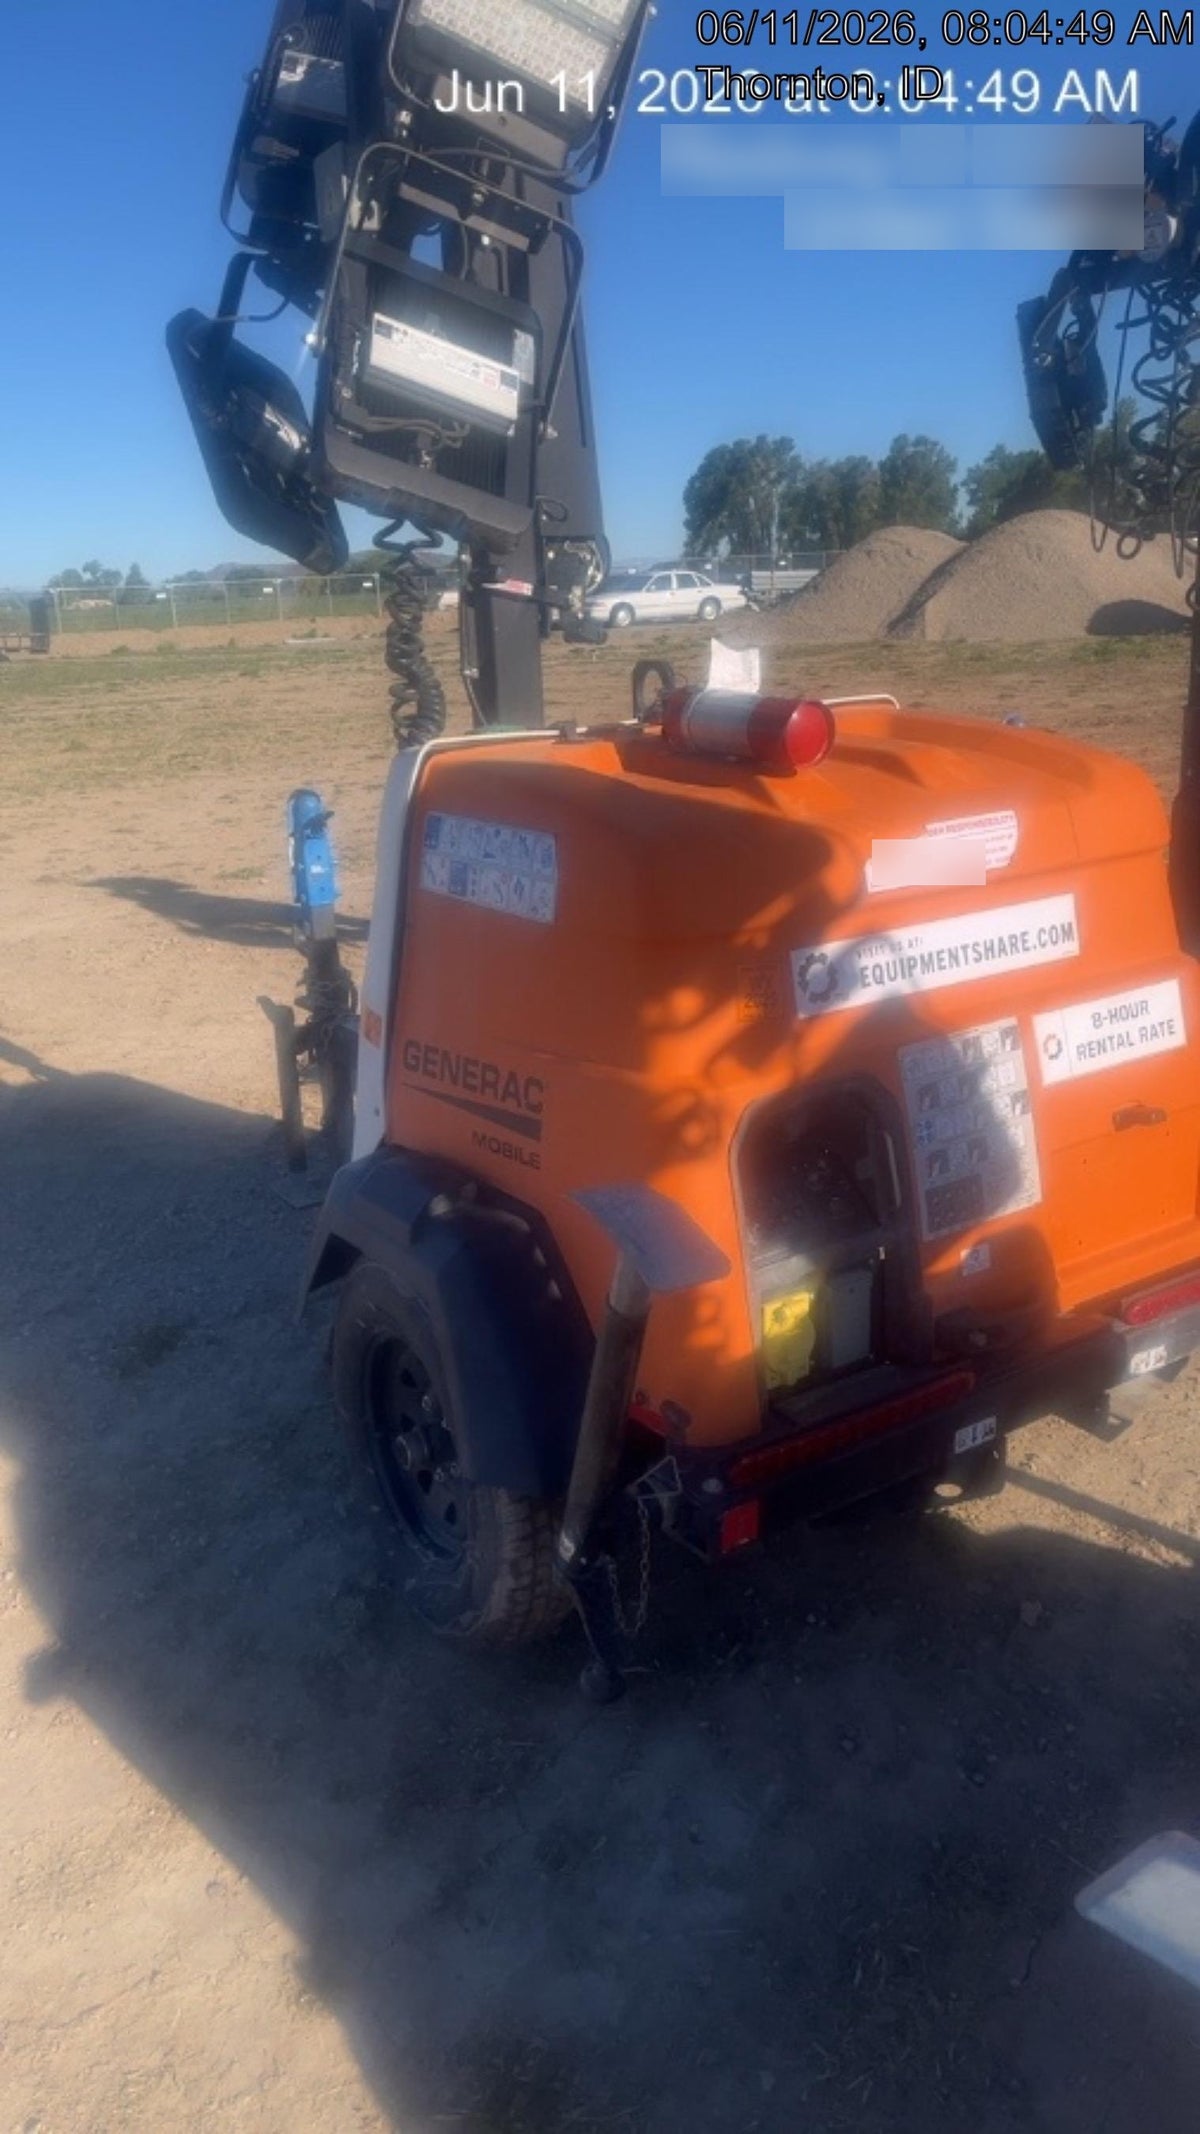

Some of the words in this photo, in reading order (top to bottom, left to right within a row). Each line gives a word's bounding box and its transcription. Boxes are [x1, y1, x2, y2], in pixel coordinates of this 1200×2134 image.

[860, 921, 1075, 988] EQUIPMENTSHARE.COM
[1091, 999, 1151, 1030] 8-HOUR
[1076, 1030, 1135, 1062] RENTAL
[1138, 1019, 1176, 1043] RATE
[402, 1039, 545, 1115] GENERAC
[471, 1130, 542, 1170] MOBILE
